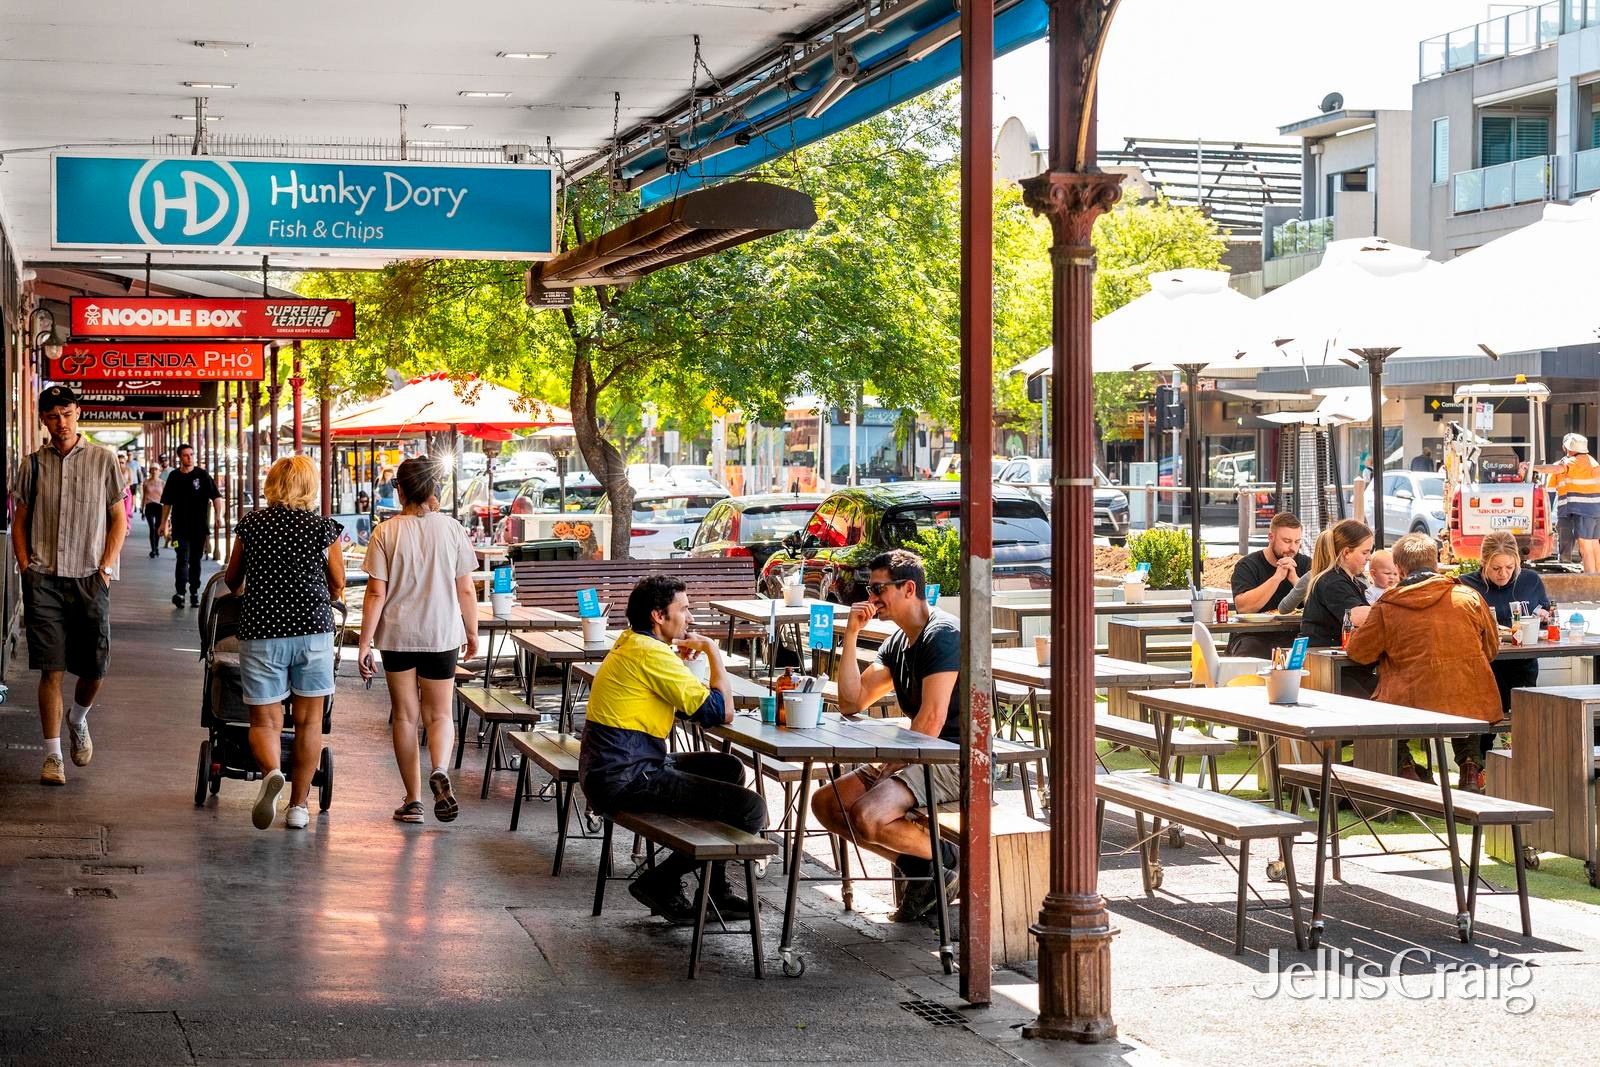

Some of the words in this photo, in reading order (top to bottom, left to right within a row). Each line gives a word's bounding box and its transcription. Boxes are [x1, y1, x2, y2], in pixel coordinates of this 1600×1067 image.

[270, 169, 377, 216] Hunky
[383, 171, 468, 218] Dory
[268, 219, 307, 239] Fish
[312, 220, 328, 239] &
[331, 221, 385, 243] Chips
[102, 308, 192, 327] NOODLE
[196, 309, 242, 328] BOX
[264, 305, 328, 317] SUPREME
[271, 316, 323, 327] LEADER
[101, 351, 198, 368] GLENDA
[103, 369, 193, 377] Vietnamese
[197, 369, 254, 377] Cuisine
[82, 410, 145, 420] PHARMACY
[814, 613, 829, 628] 13
